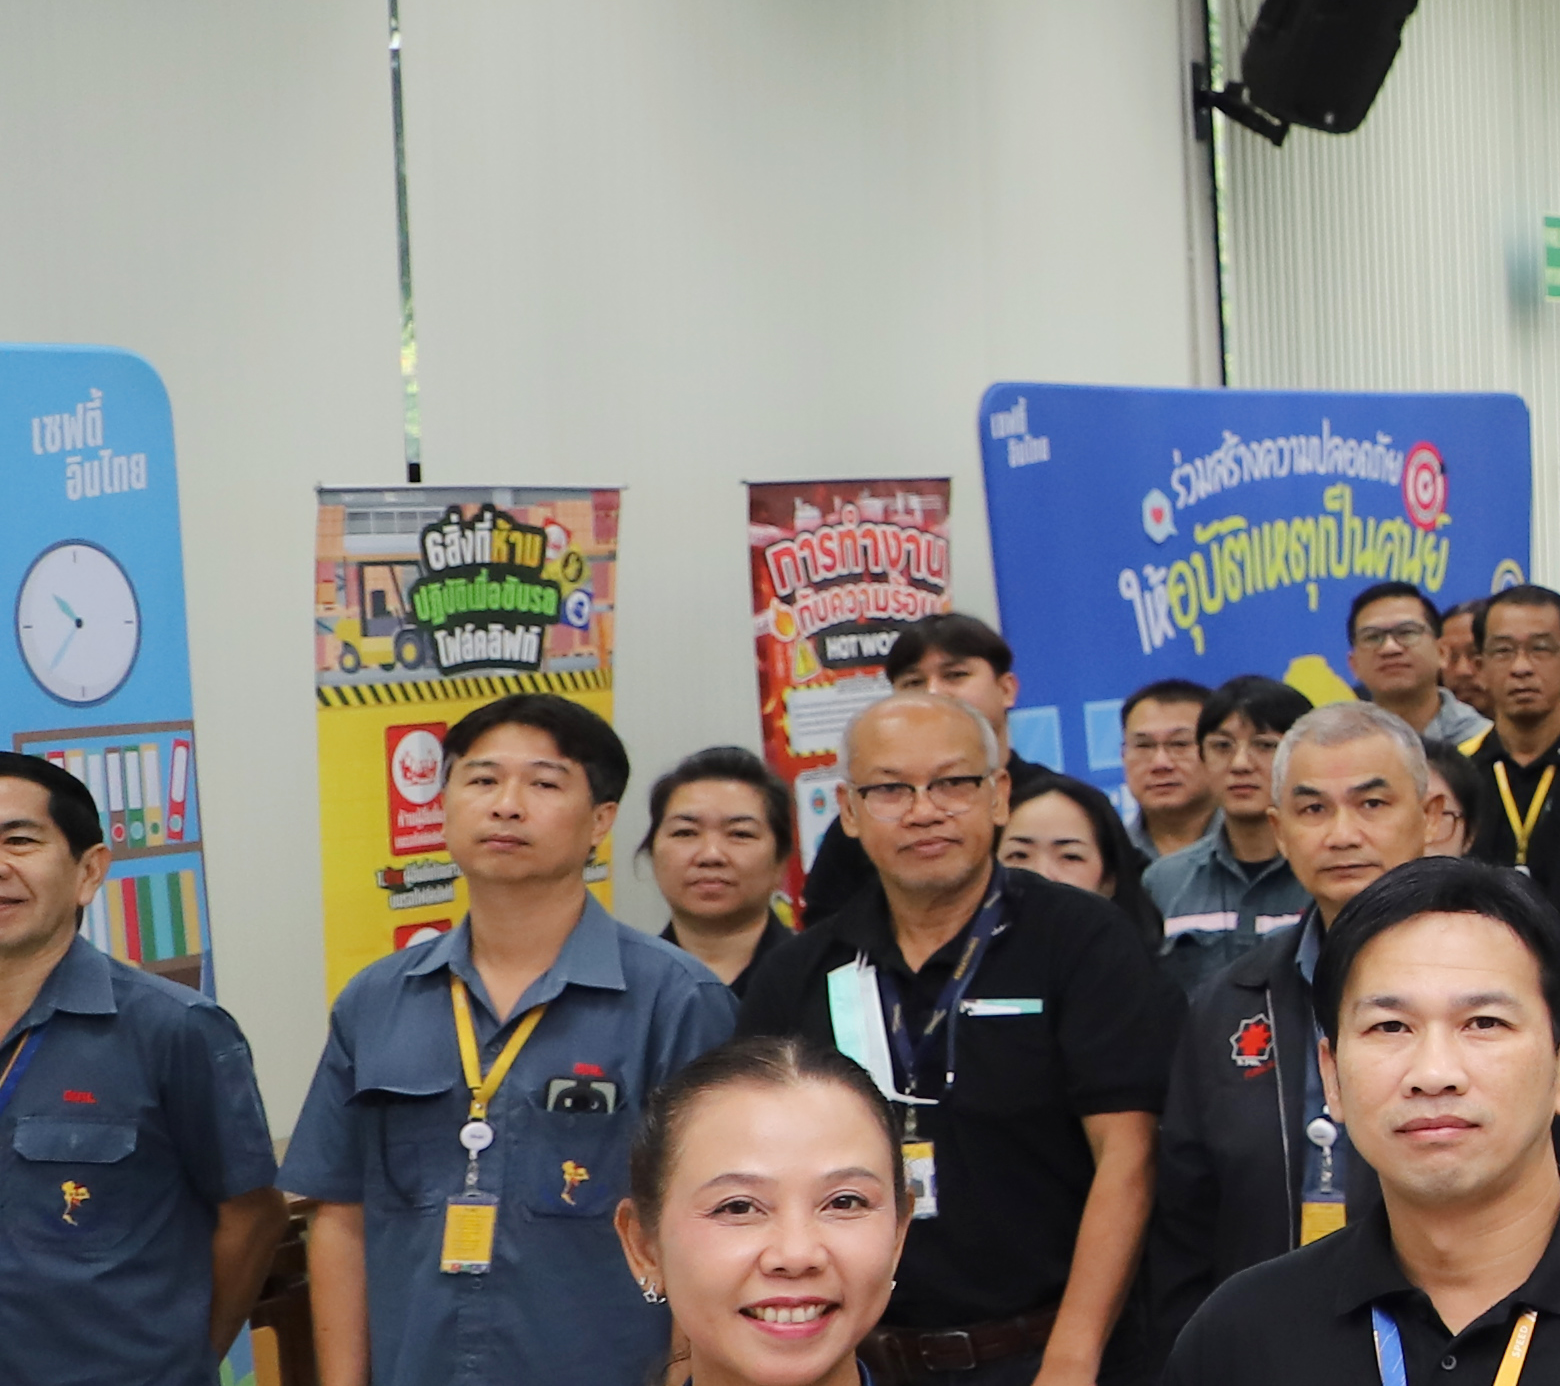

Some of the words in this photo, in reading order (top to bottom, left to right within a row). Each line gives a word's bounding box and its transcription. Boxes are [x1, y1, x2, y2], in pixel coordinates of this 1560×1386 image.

[32, 387, 103, 455] เซฟตี้
[66, 448, 147, 501] อินไทย
[1170, 418, 1405, 510] ร่วมสร้างความปลอดภัย
[767, 502, 949, 595] การทำงาน
[1119, 483, 1452, 655] ให้อุบัติเหตุเป็นศนย์
[859, 631, 900, 657] WO
[1511, 1325, 1529, 1359] SPEED
